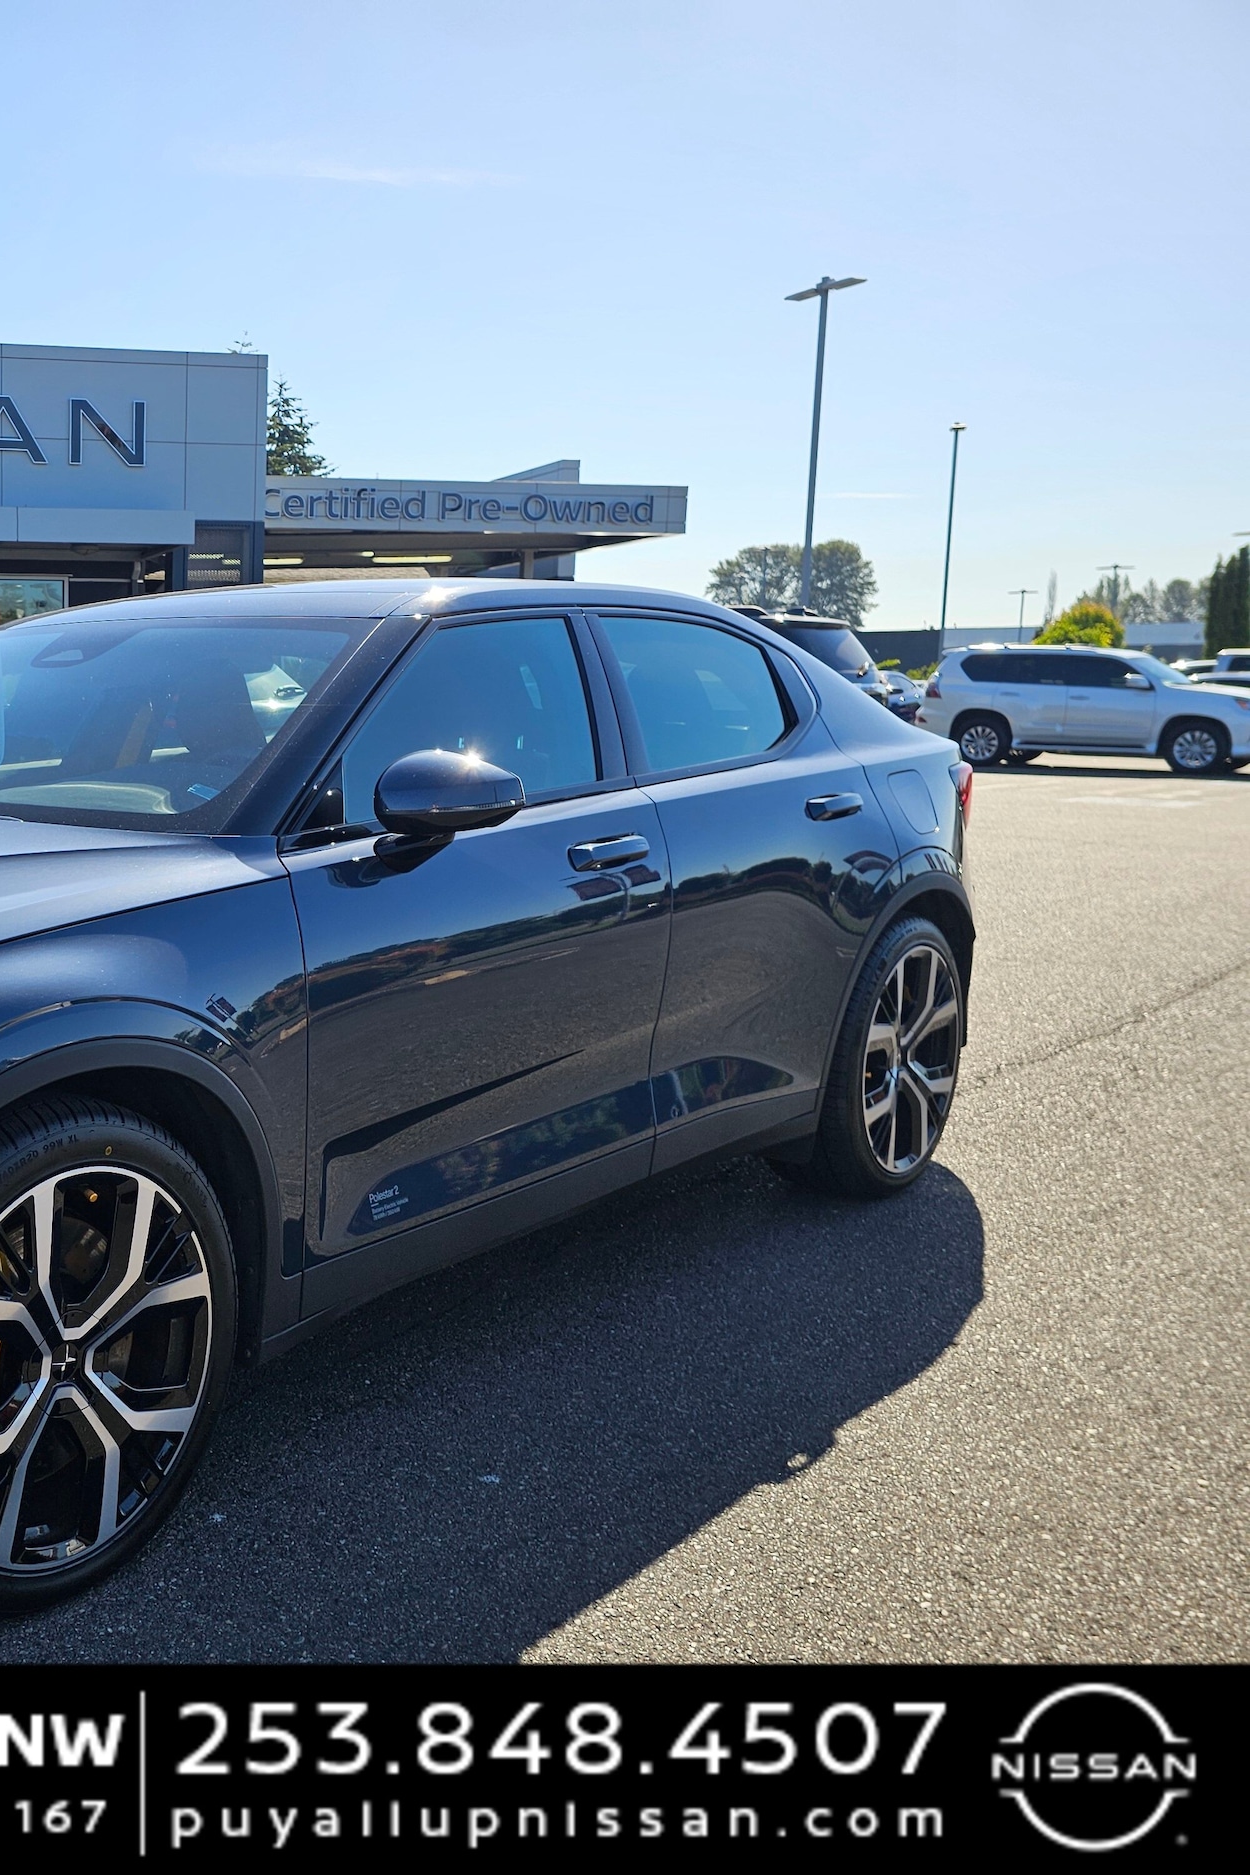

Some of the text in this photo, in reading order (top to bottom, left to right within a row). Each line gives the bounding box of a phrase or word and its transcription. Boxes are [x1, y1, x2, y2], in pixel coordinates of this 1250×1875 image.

[439, 491, 654, 524] Pre-Owned
[369, 1189, 393, 1203] Polestar
[394, 1185, 400, 1196] 2
